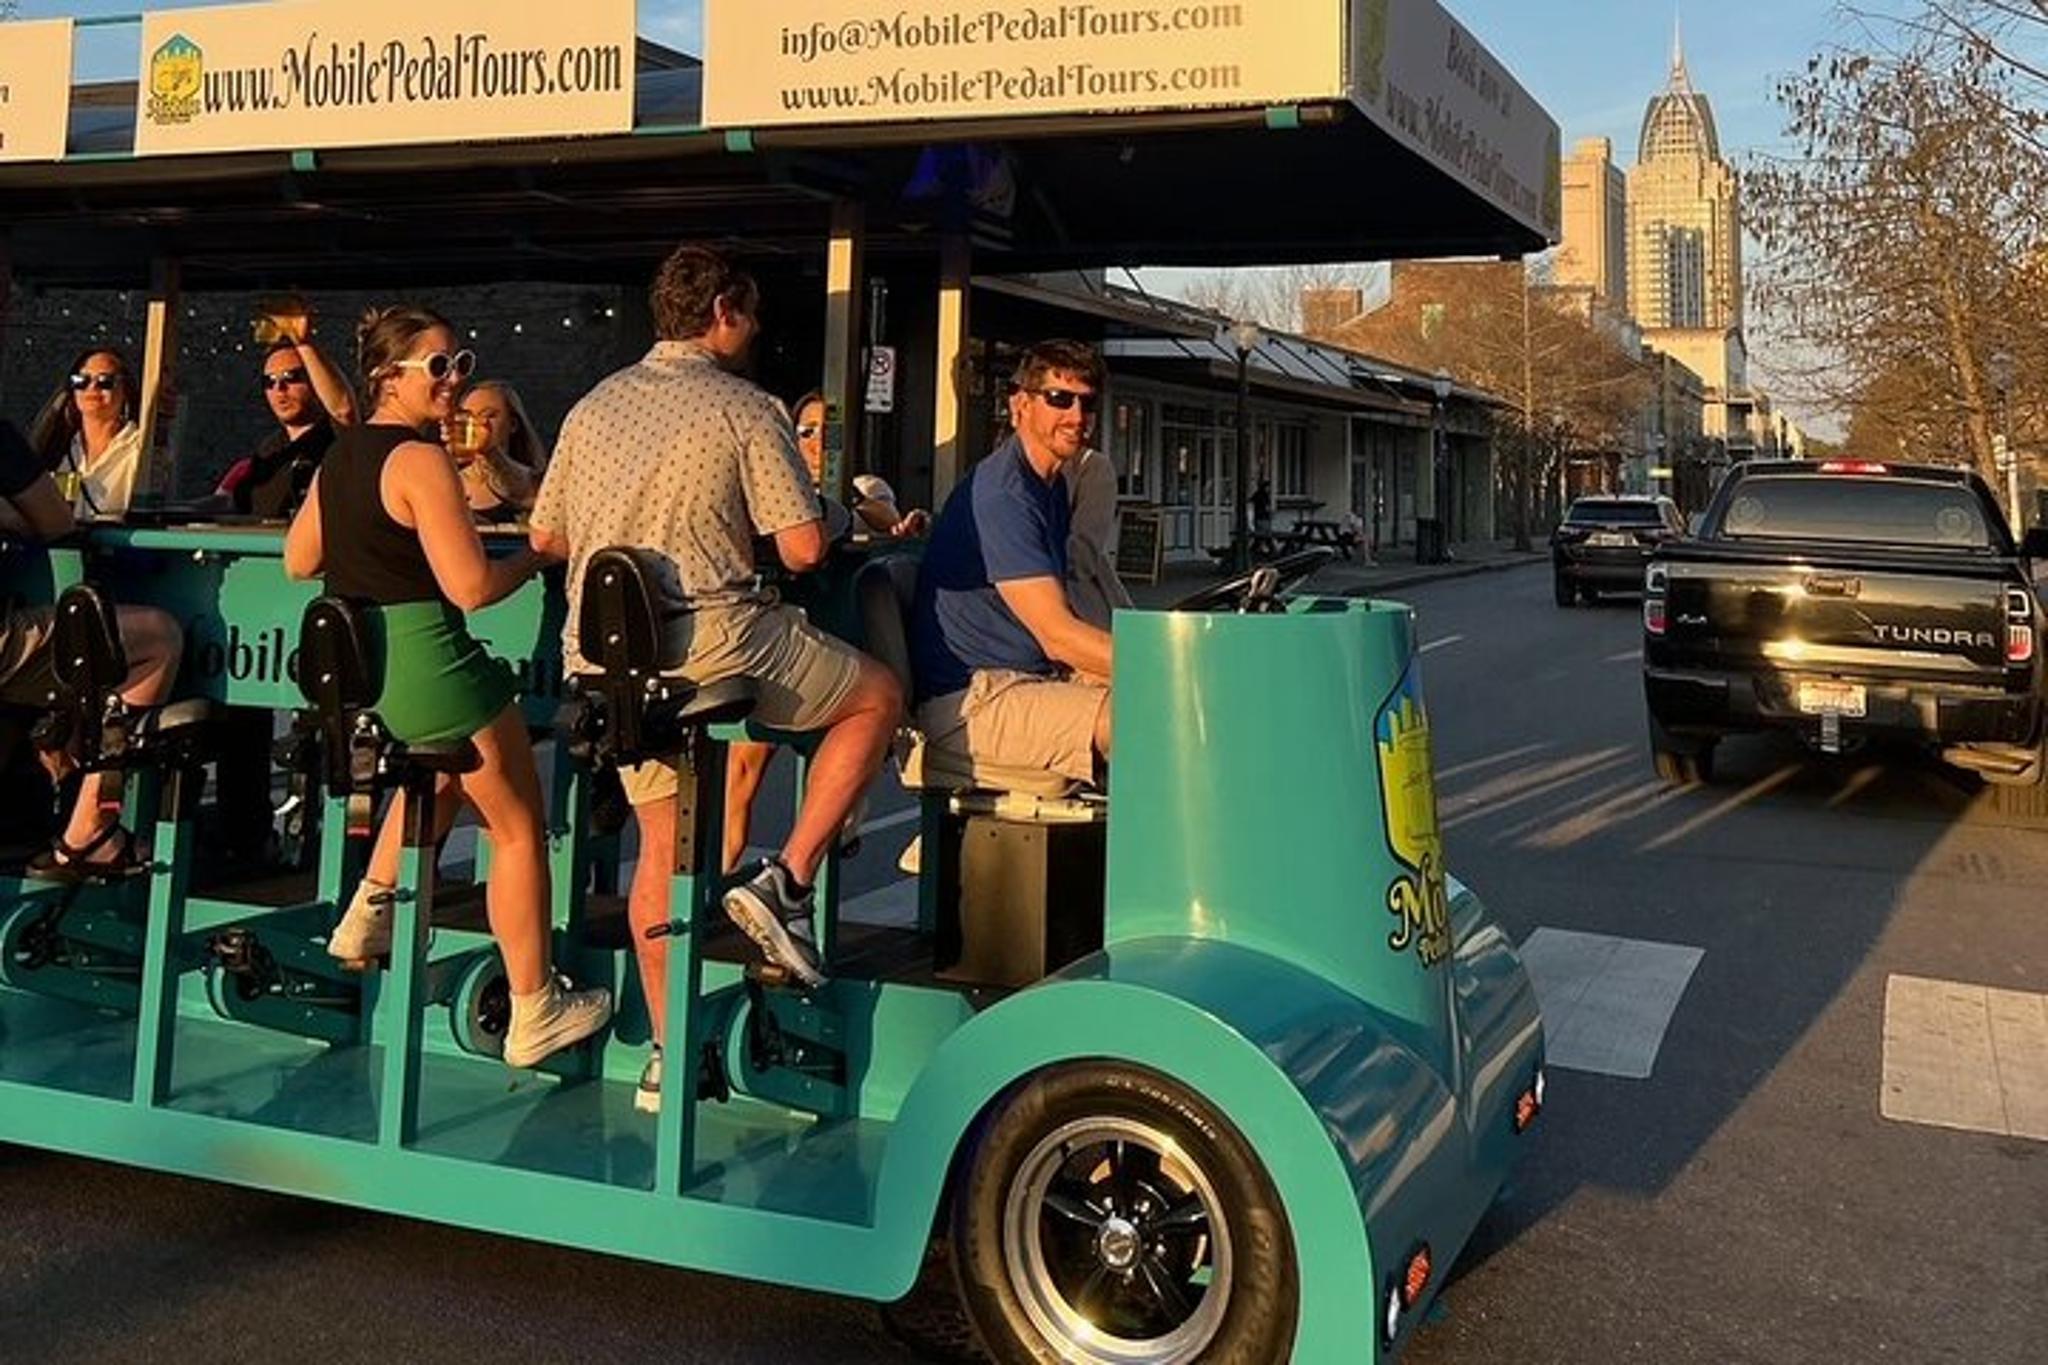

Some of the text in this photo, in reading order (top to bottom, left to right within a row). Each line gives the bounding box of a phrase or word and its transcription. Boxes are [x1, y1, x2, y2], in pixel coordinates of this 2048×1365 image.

[781, 4, 1242, 63] info@MobilePedalTours.com
[204, 31, 621, 114] www.MobilePedalTours.com
[781, 63, 1241, 110] www.MobilePedalTours.com
[1873, 624, 1995, 649] TUNDRA
